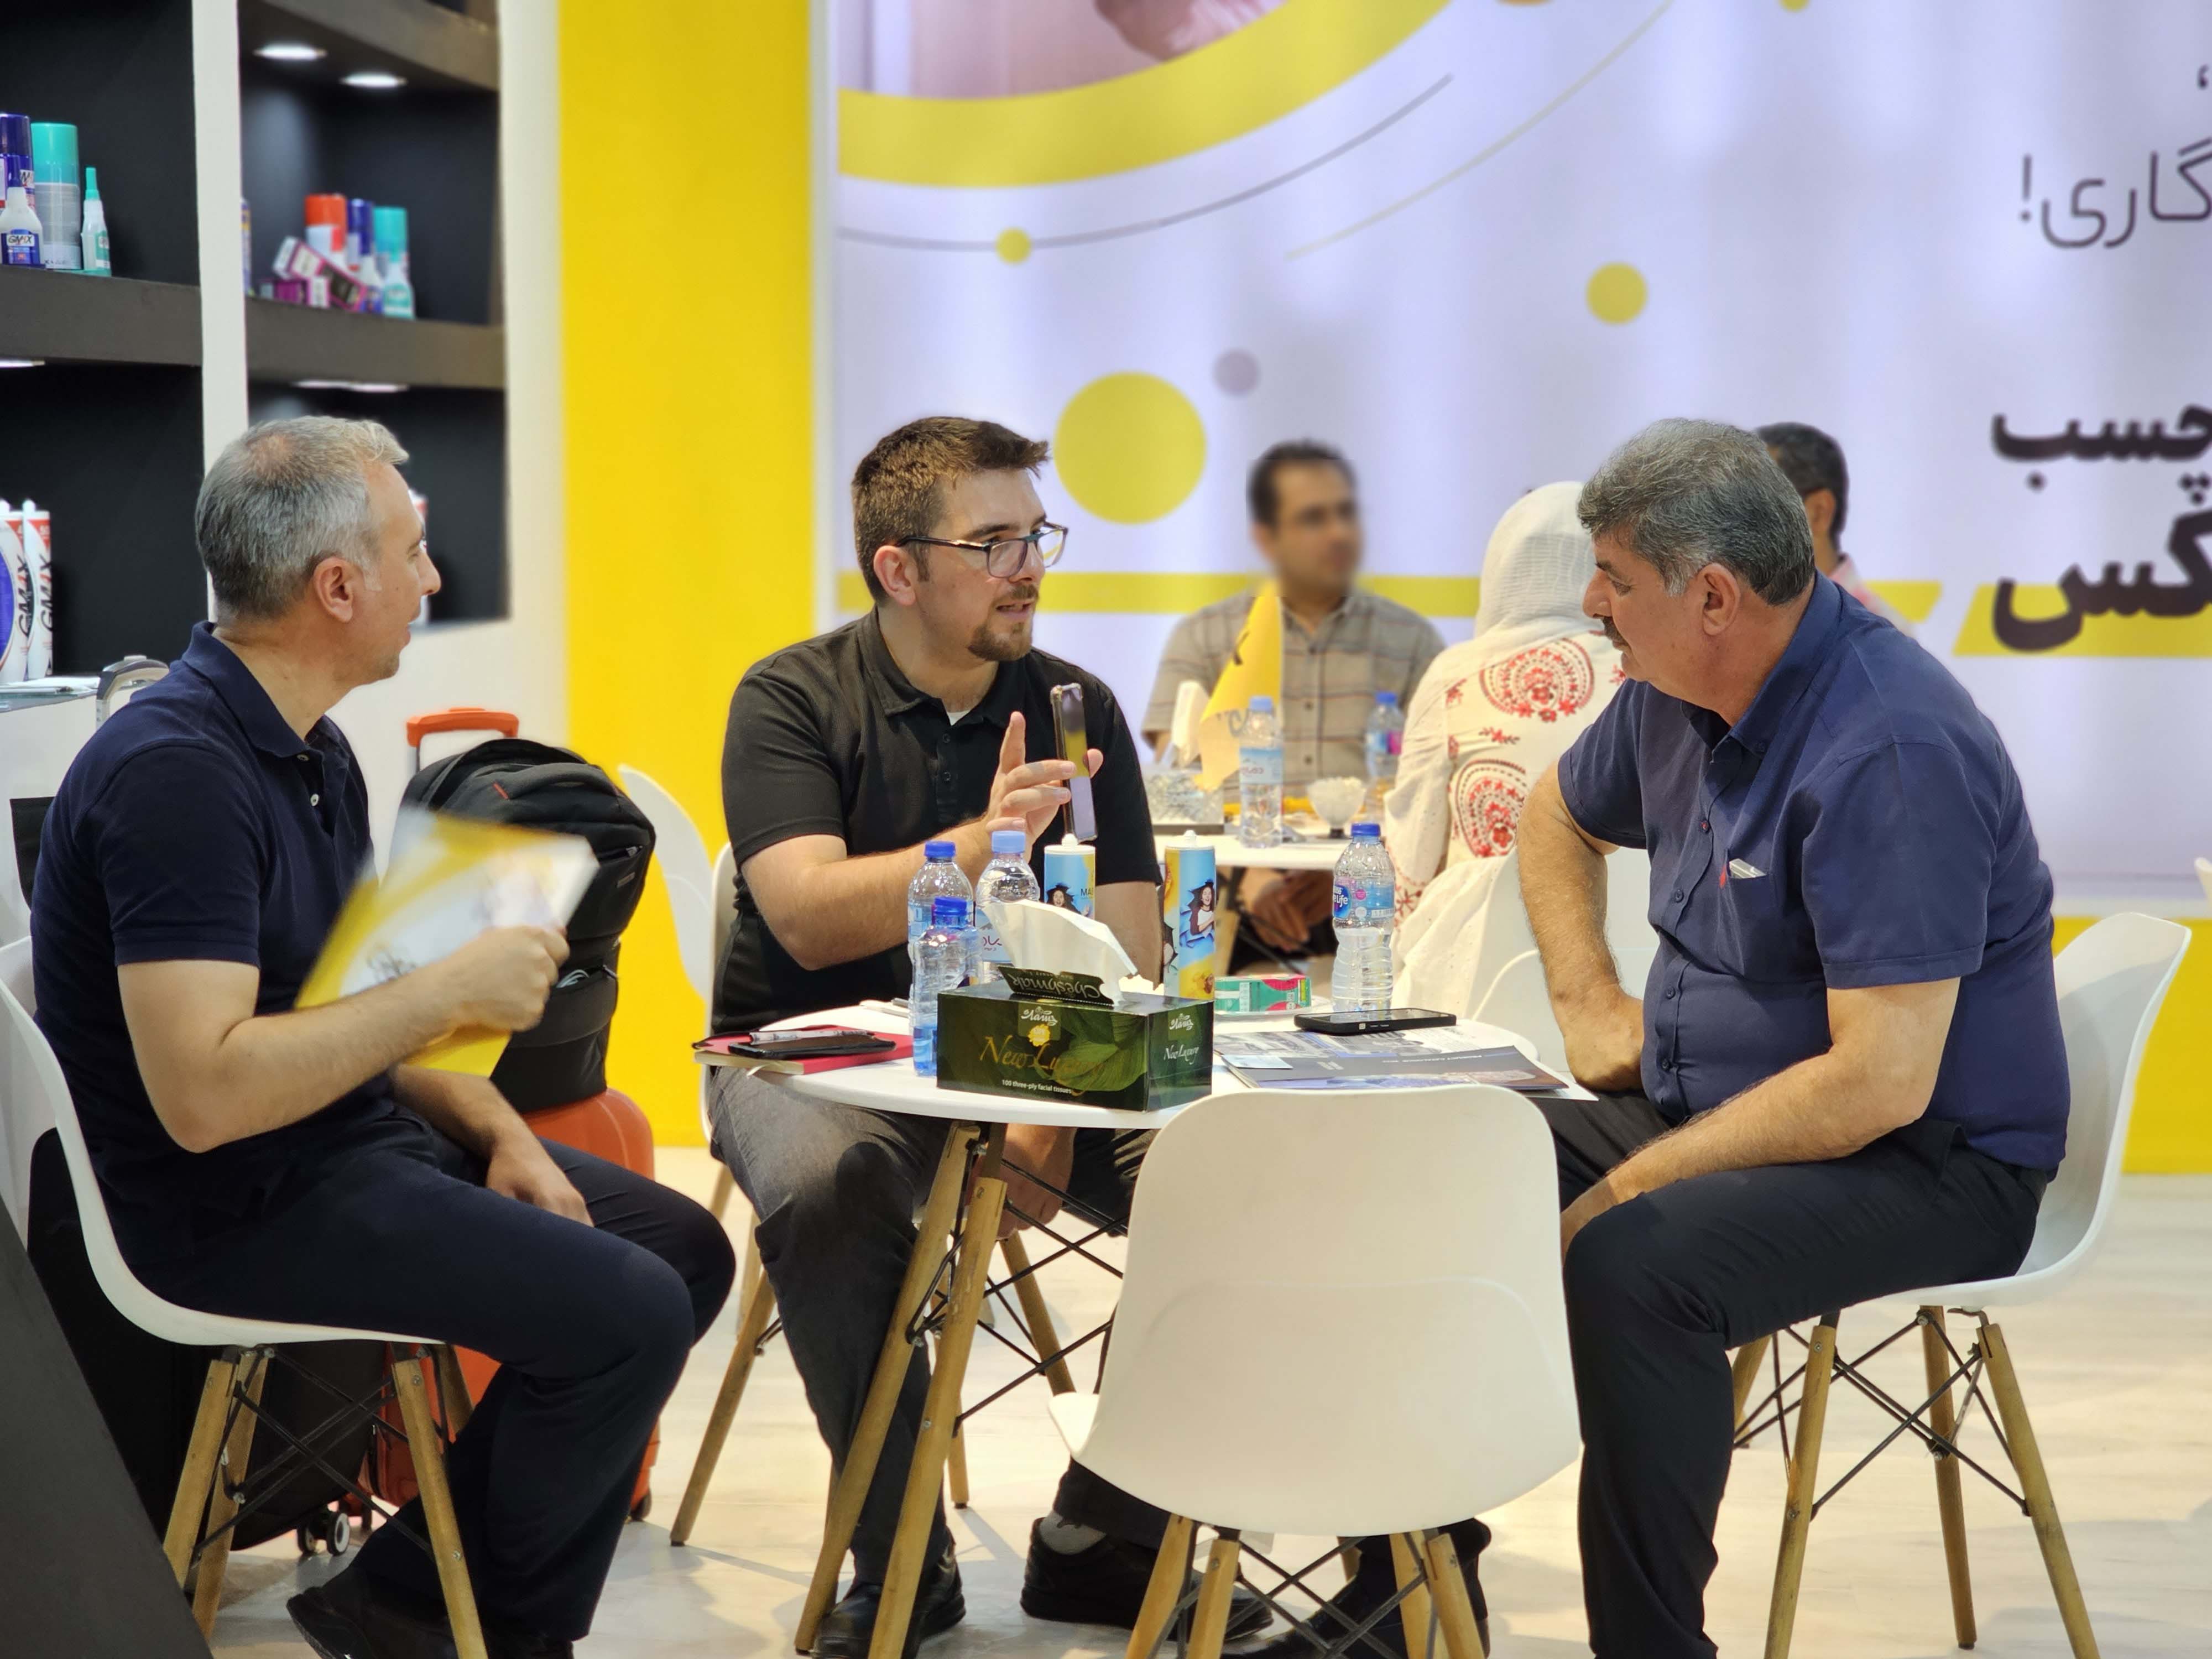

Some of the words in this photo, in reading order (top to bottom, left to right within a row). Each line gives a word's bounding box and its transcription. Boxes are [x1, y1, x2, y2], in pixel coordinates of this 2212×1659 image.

[1008, 973, 1100, 999] Cheshmak
[979, 1035, 1027, 1070] New
[1013, 1081, 1037, 1091] three-ply
